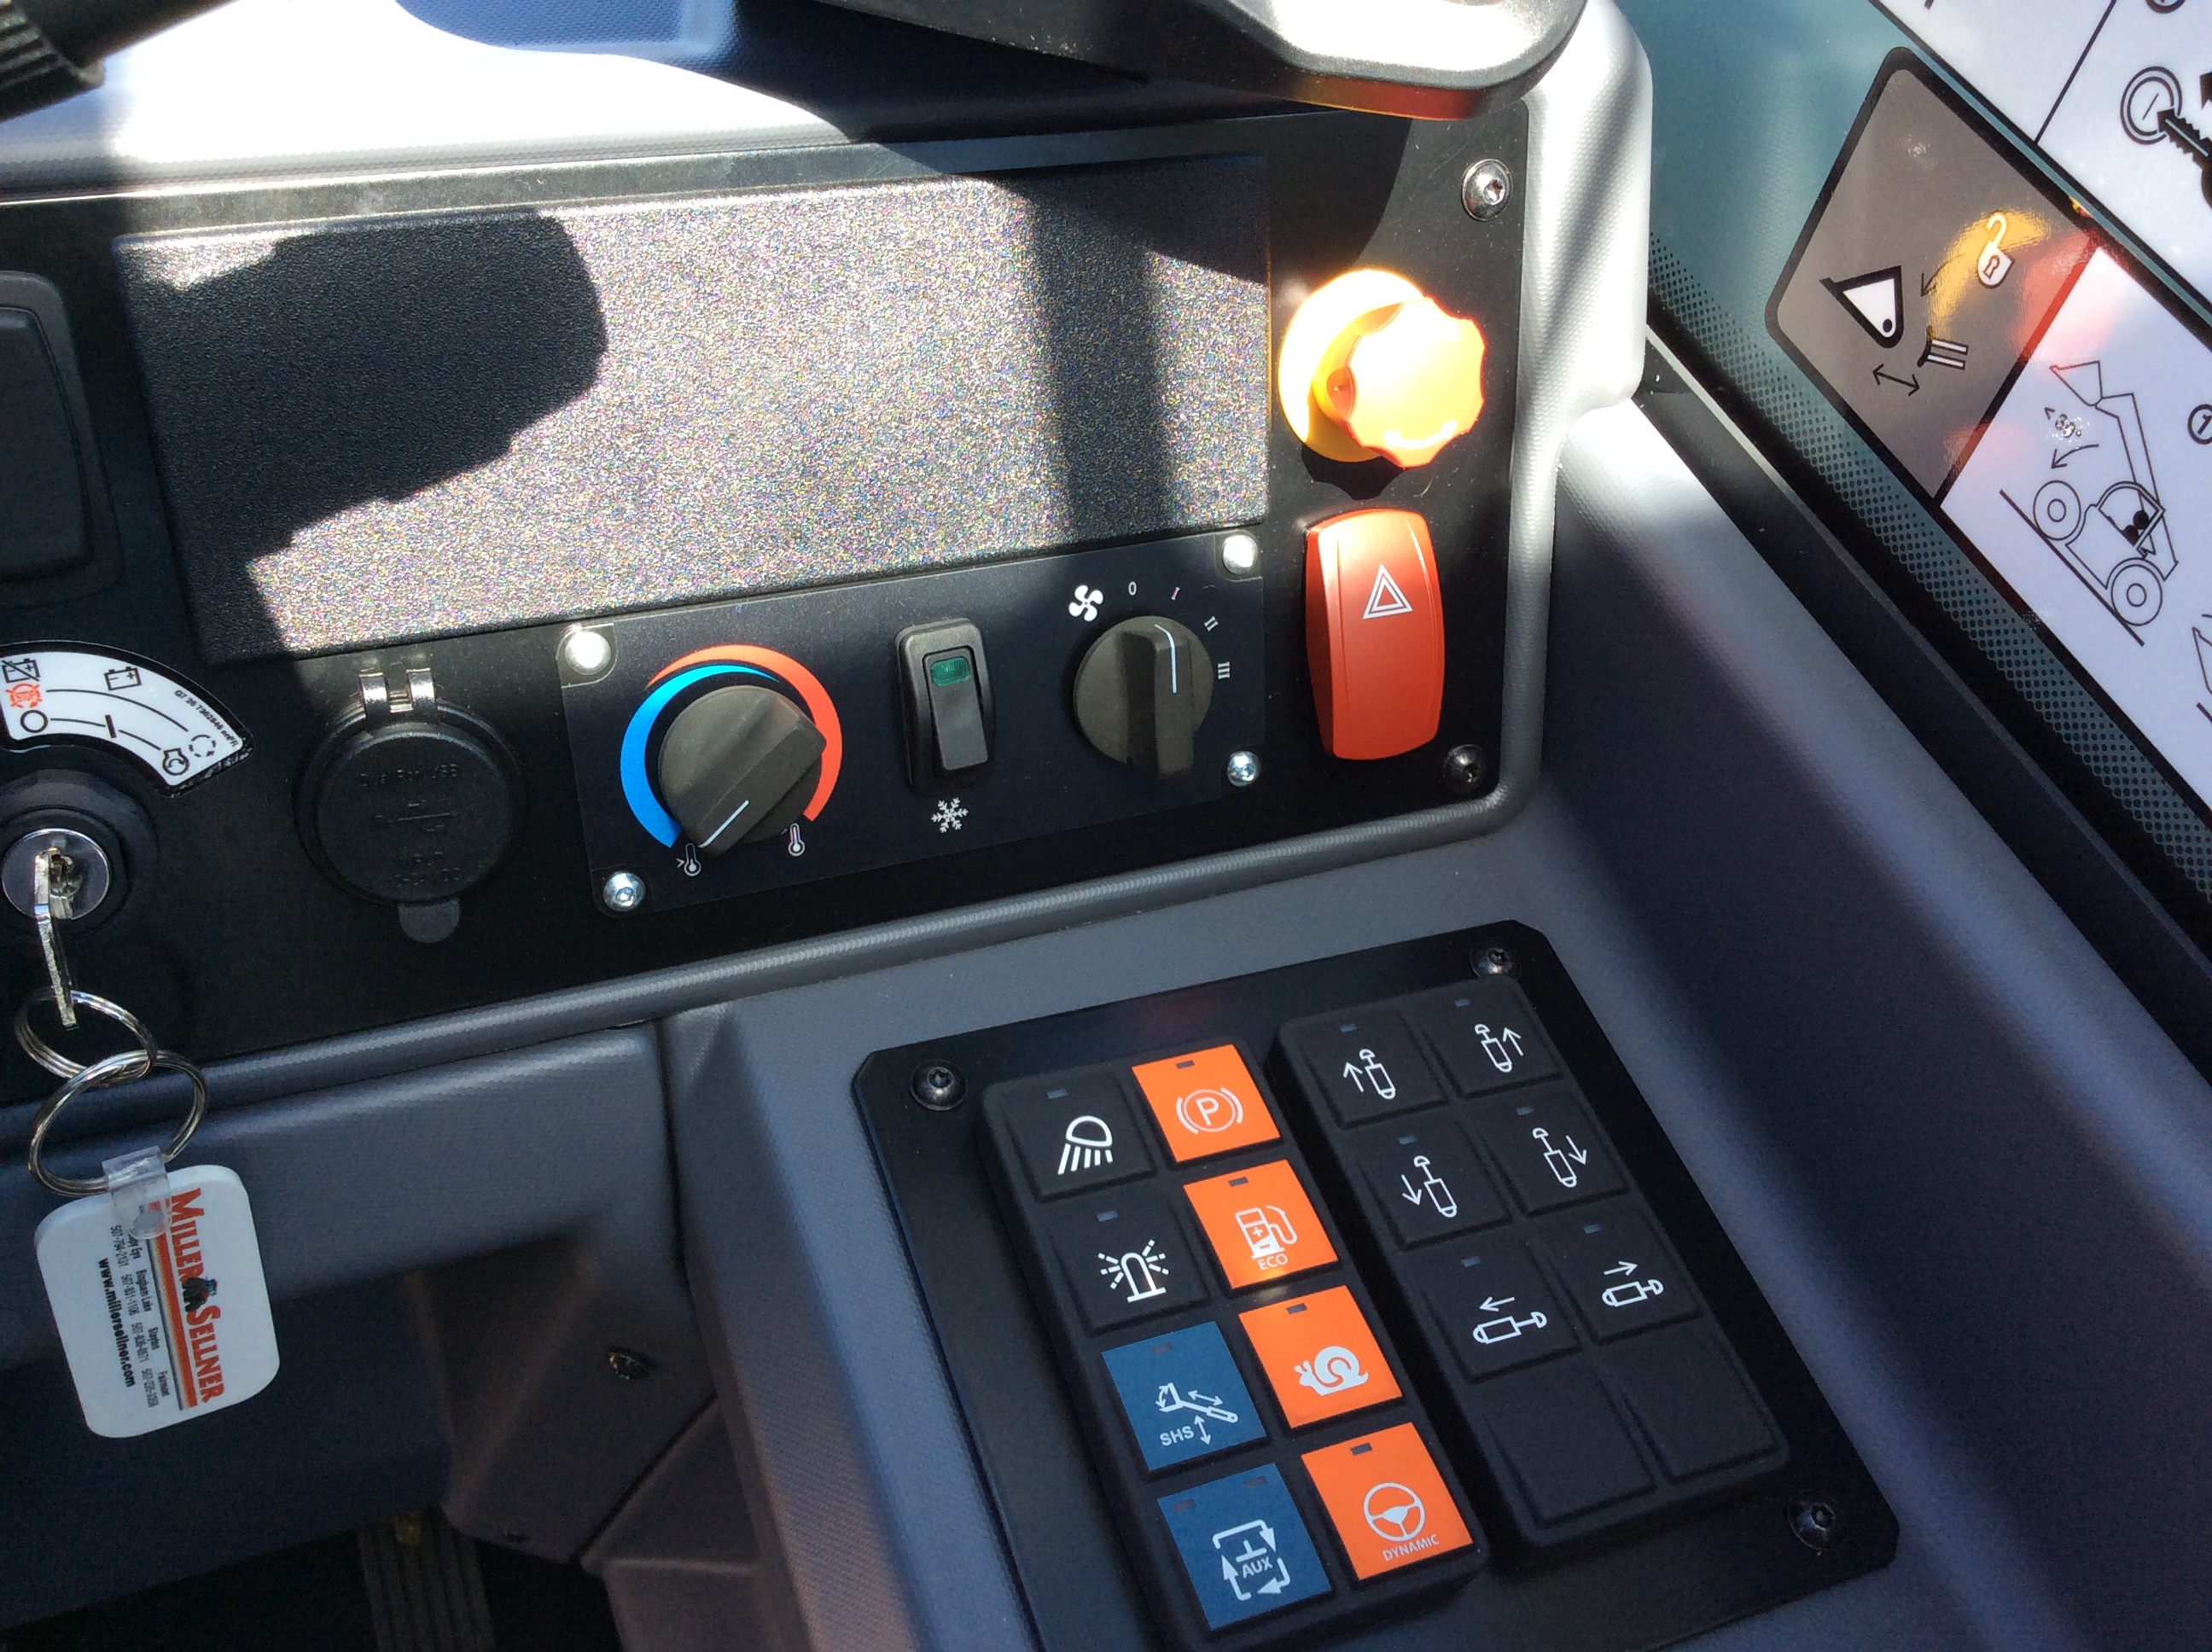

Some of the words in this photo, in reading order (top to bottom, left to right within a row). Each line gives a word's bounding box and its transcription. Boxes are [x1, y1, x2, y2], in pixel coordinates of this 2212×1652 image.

[1257, 1253, 1289, 1271] ECO
[165, 1187, 205, 1285] MILLER
[186, 1305, 224, 1404] SELLNER
[98, 1257, 136, 1387] www.millersellner.com
[1160, 1425, 1195, 1446] SHS
[1382, 1533, 1440, 1562] DYNAMIC
[1242, 1556, 1273, 1579] AUX
